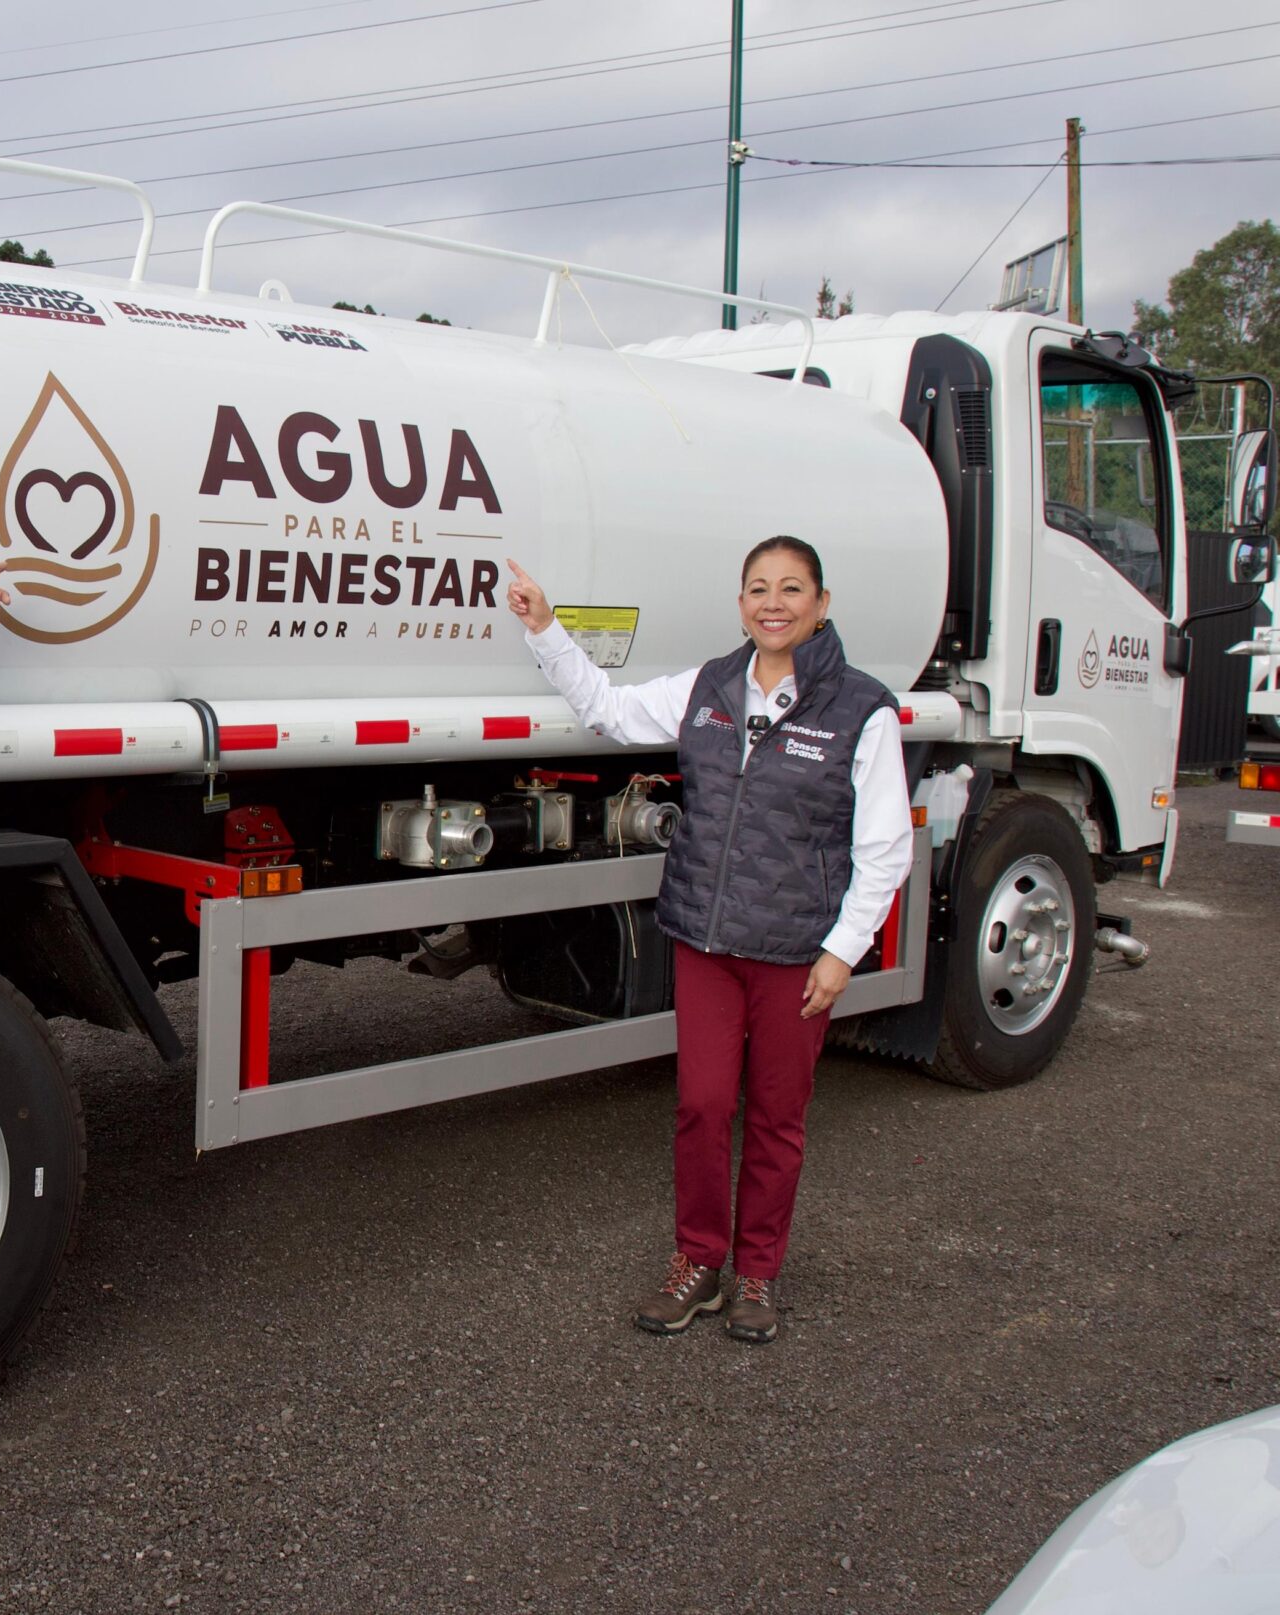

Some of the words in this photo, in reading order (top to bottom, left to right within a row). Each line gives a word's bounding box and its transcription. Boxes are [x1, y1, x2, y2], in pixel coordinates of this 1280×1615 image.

[49, 310, 91, 323] 2030
[113, 301, 248, 330] Bienestar
[276, 329, 369, 352] PUEBLA
[291, 324, 347, 338] AMOR
[198, 404, 503, 514] AGUA
[284, 514, 371, 541] PARA
[391, 520, 424, 544] EL
[194, 547, 499, 608] BIENESTAR
[189, 619, 248, 638] POR
[268, 620, 348, 638] AMOR
[366, 622, 379, 638] A
[398, 622, 492, 640] PUEBLA
[1107, 635, 1150, 661] AGUA
[1105, 668, 1149, 684] BIENESTAR
[780, 722, 836, 740] Bienestar
[785, 746, 825, 762] Grande
[786, 738, 823, 753] Pensar
